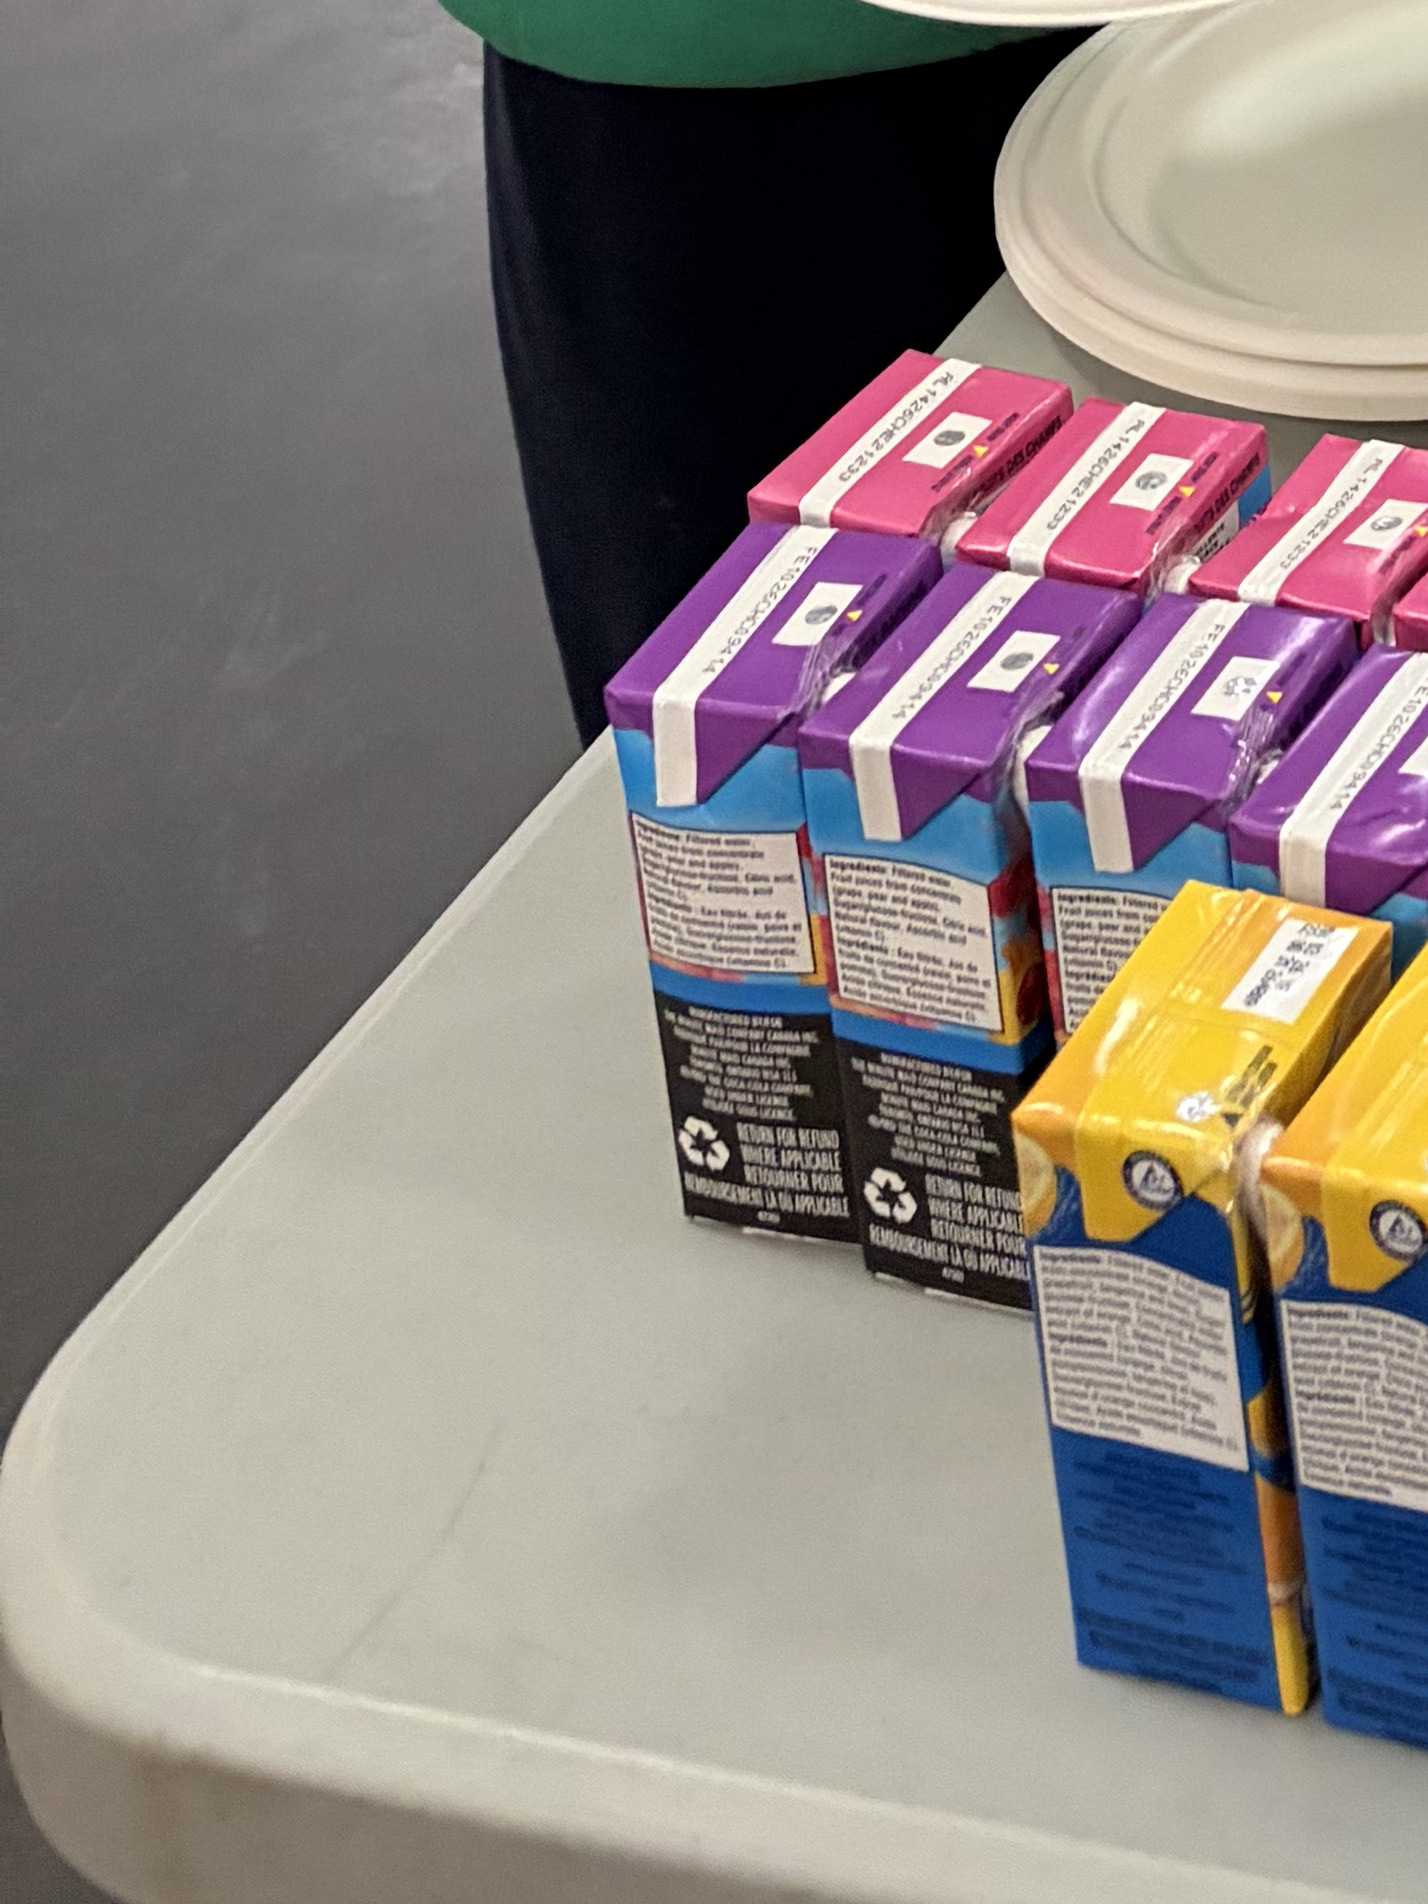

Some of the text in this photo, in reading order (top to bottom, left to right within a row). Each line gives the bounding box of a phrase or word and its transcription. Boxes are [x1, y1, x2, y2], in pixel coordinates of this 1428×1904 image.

[737, 1122, 839, 1153] RETURN FOR REFUND
[740, 1144, 841, 1176] WHERE APPLICABLE
[744, 1165, 844, 1195] RETOURNER POUR
